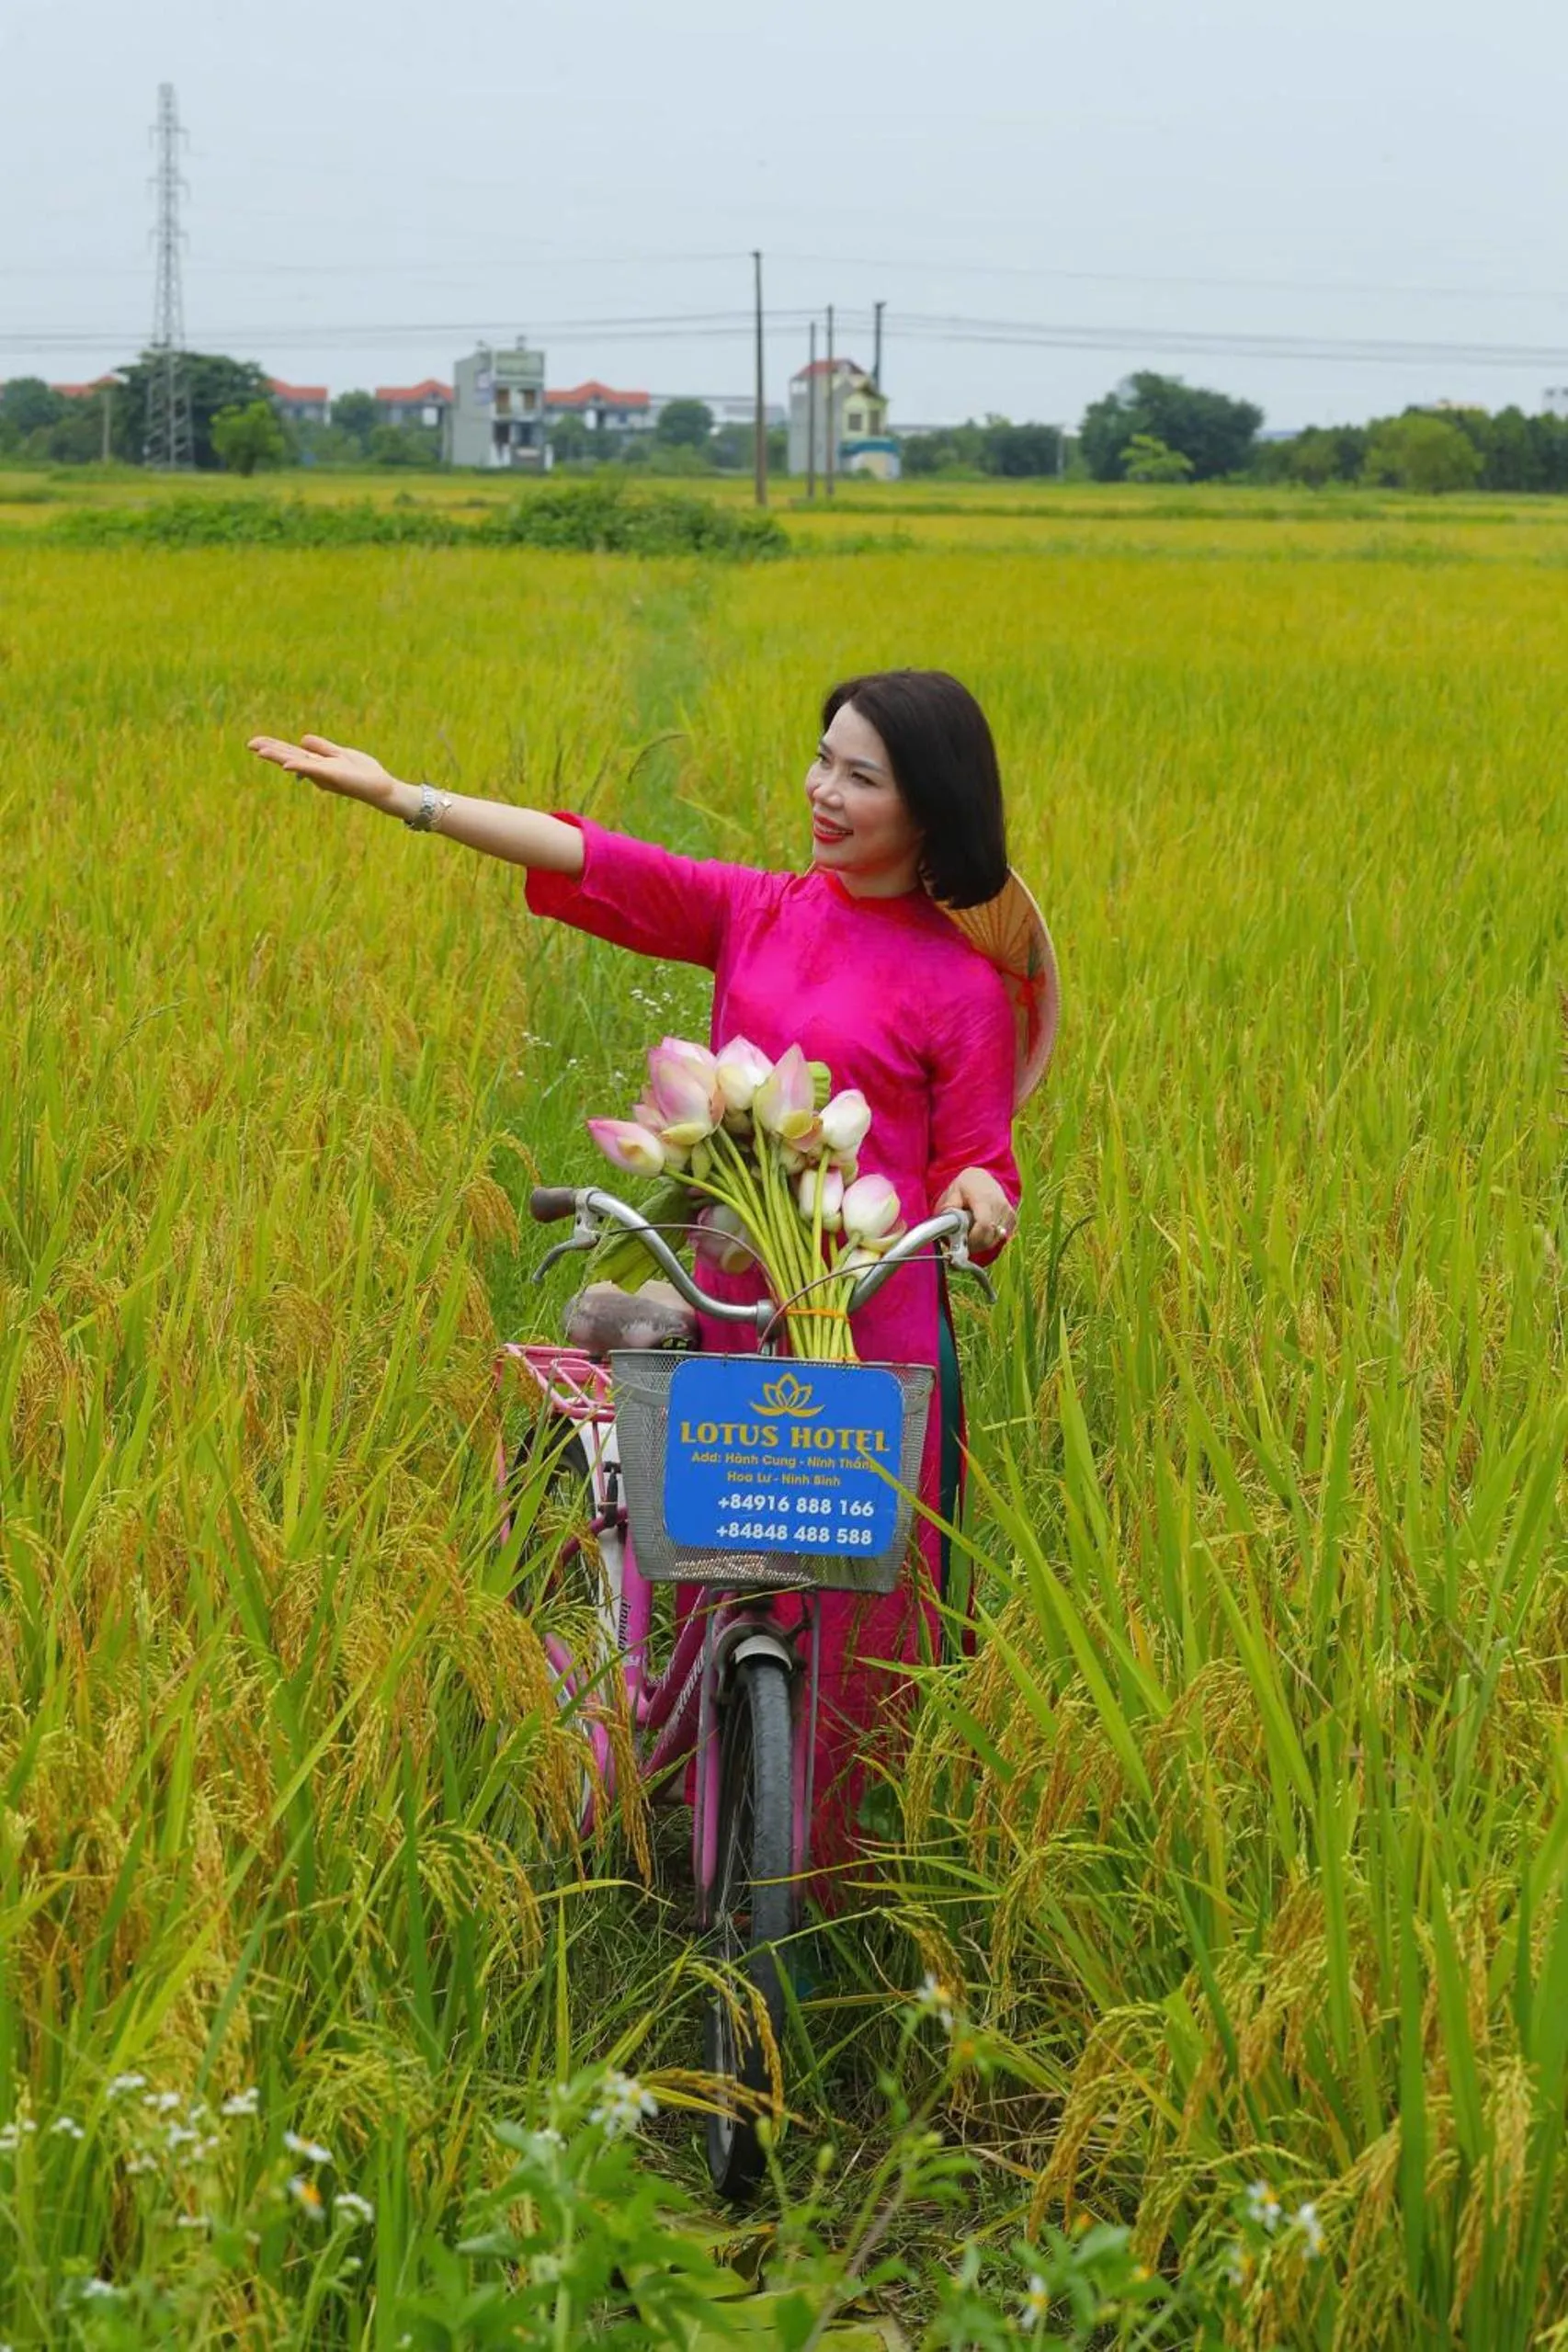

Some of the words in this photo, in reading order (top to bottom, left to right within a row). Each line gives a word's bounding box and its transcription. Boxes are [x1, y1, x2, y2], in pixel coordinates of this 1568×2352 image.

[680, 1422, 779, 1448] LOTUS
[790, 1426, 891, 1452] HOTEL
[691, 1451, 722, 1463] Add:
[762, 1455, 797, 1469] Cung
[807, 1457, 835, 1469] Ninh
[727, 1471, 753, 1483] Hoa
[781, 1473, 810, 1485] Ninh
[718, 1493, 790, 1512] +84916
[796, 1497, 832, 1515] 888
[839, 1500, 874, 1517] 166
[716, 1521, 788, 1541] +84848
[793, 1525, 830, 1543] 488
[836, 1528, 872, 1545] 588
